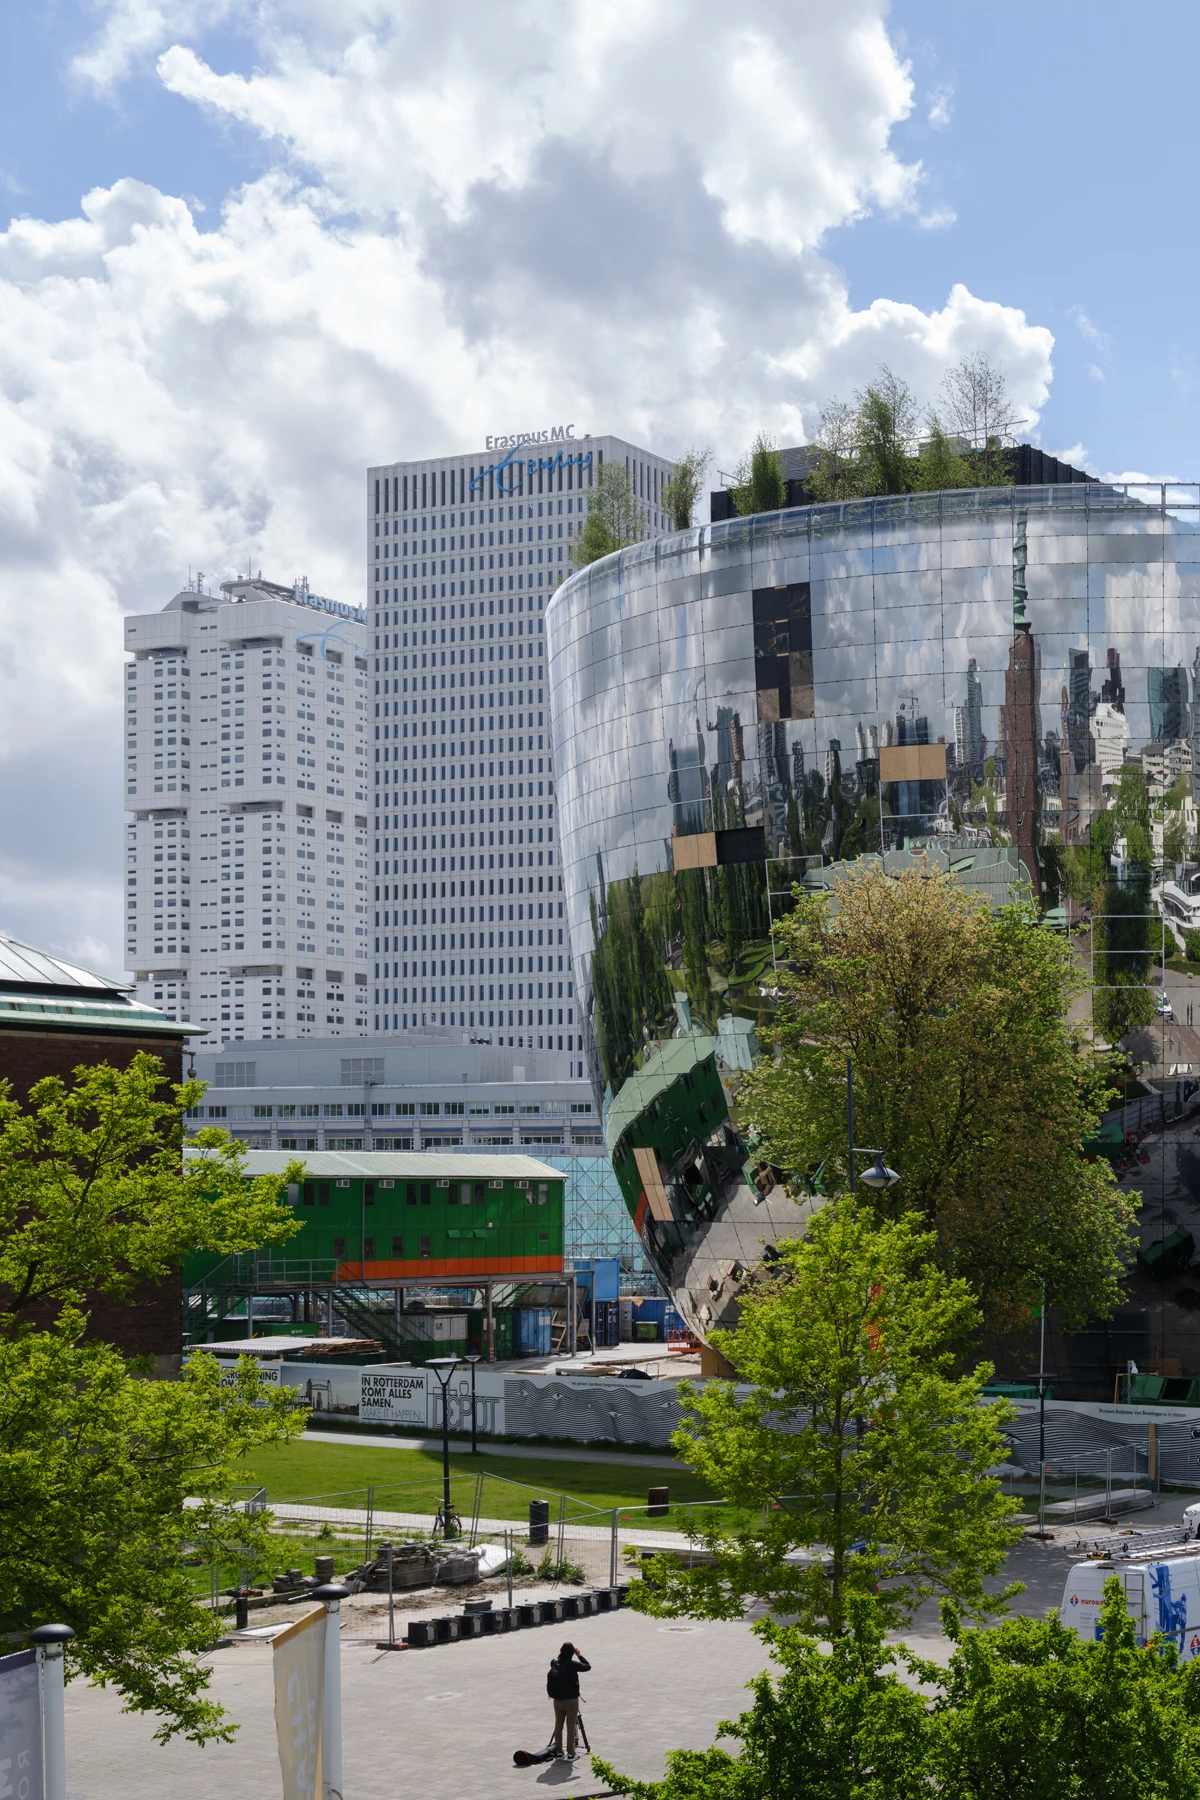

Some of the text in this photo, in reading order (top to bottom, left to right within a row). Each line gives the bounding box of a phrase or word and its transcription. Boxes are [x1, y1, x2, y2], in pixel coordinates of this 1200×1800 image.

[486, 424, 574, 450] Erasmus MC
[294, 585, 356, 618] Erasmus
[362, 1376, 424, 1389] IN ROTTERDAM
[362, 1387, 412, 1399] KOMT ALLES
[362, 1397, 394, 1408] SAMEN.
[362, 1408, 423, 1421] MAKE IT HAPPEN.
